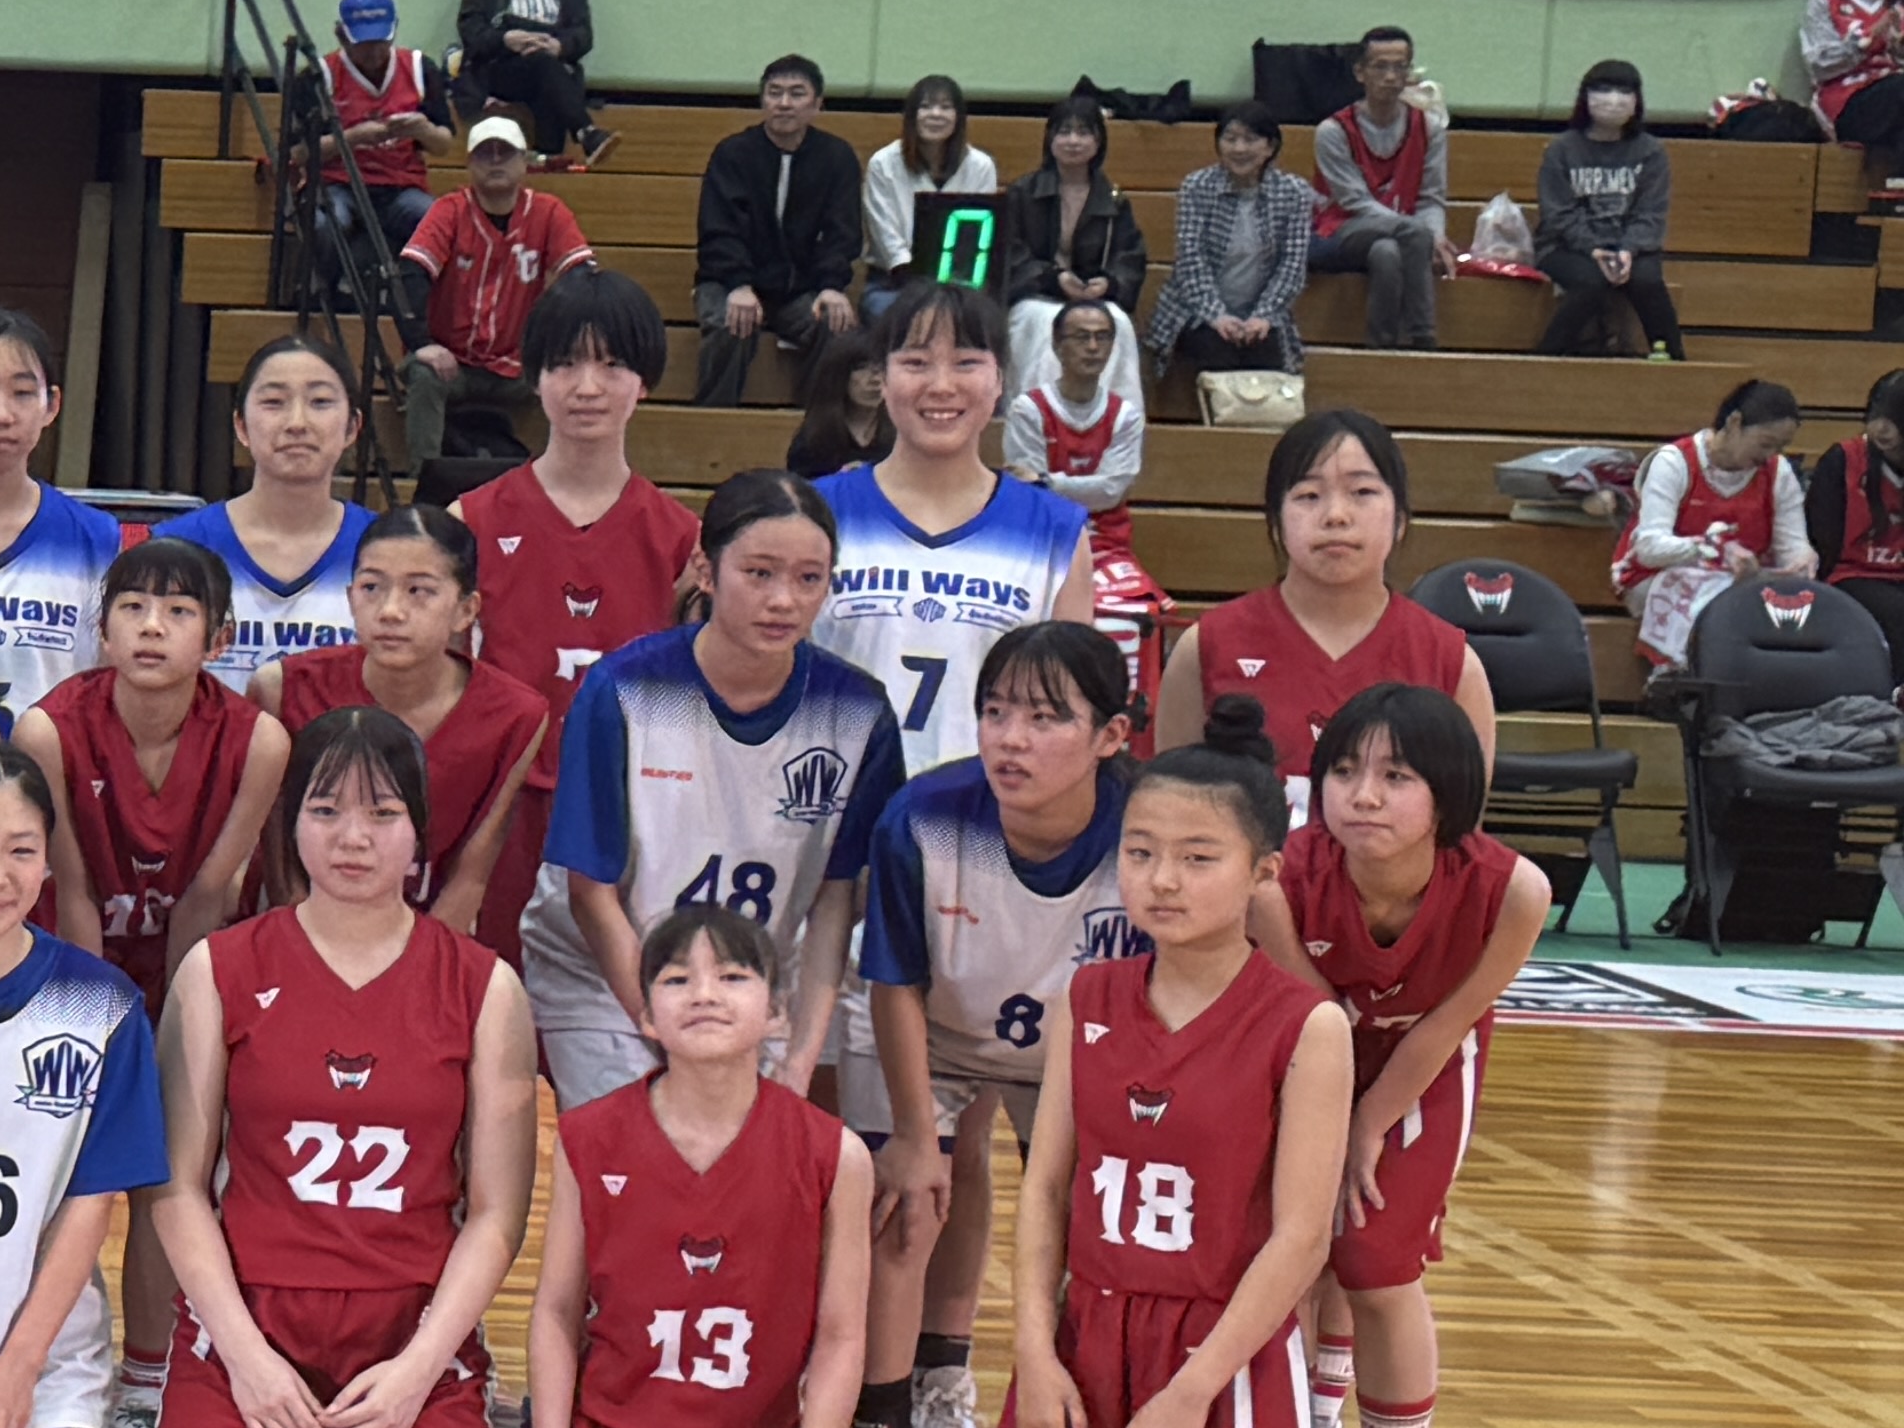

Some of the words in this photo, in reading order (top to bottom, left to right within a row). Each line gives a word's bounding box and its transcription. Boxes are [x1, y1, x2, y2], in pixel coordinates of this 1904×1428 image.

[937, 209, 994, 289] 0
[275, 621, 356, 648] Way
[900, 655, 949, 732] 7
[673, 853, 777, 924] 48
[995, 992, 1045, 1049] 8
[282, 1120, 412, 1214] 22
[1091, 1155, 1196, 1253] 18
[646, 1305, 754, 1390] 13
